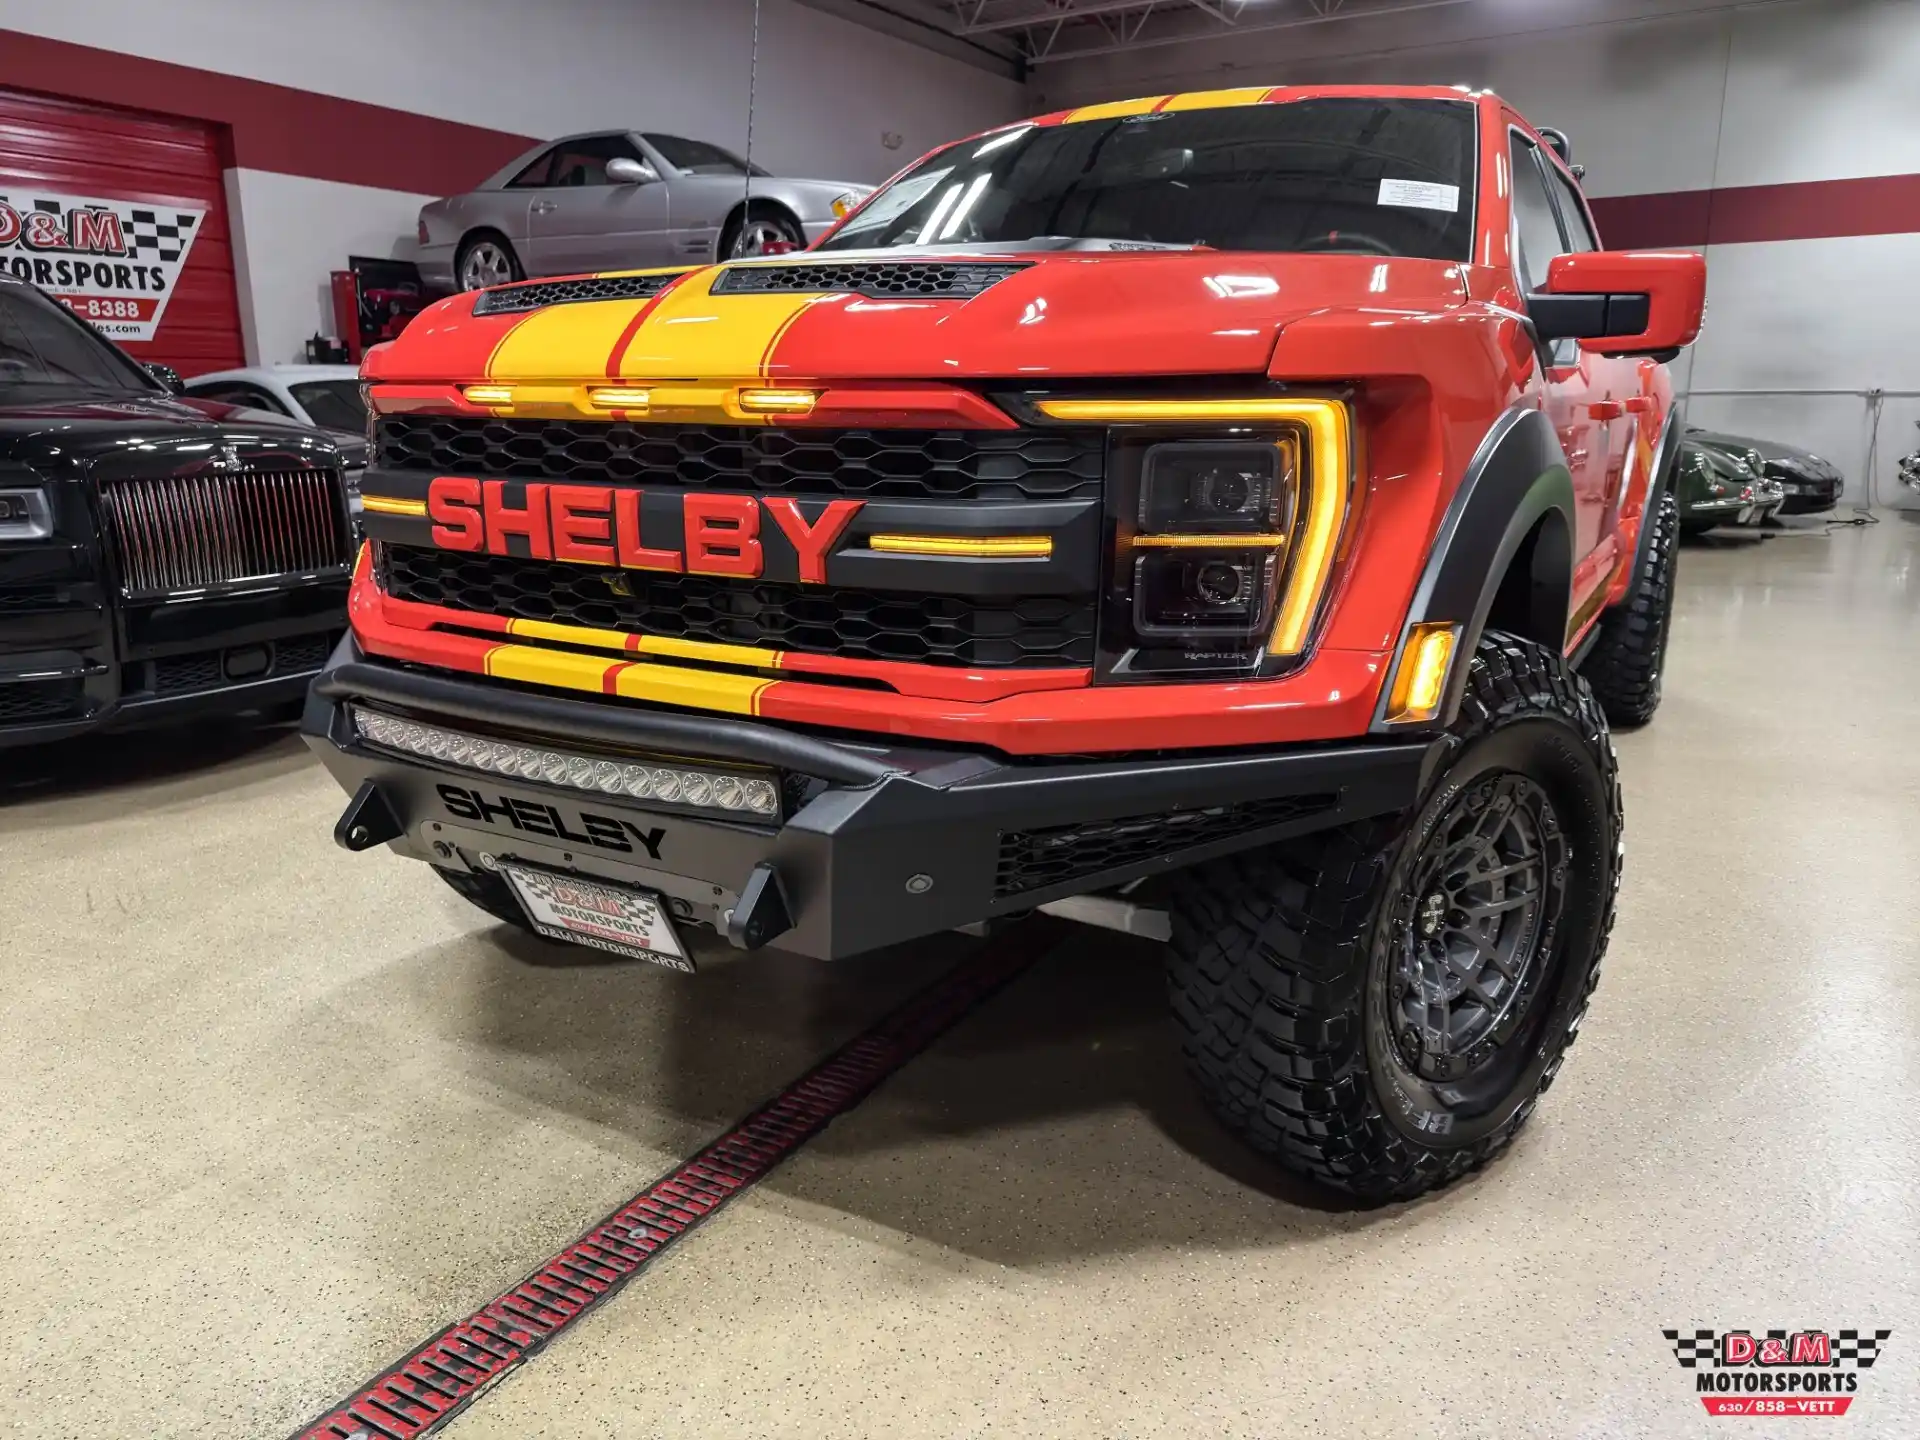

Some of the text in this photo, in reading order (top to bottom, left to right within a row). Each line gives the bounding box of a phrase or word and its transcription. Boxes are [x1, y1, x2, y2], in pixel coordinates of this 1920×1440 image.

[428, 477, 869, 584] SHELBY
[436, 783, 666, 860] SHELBY
[537, 924, 690, 973] D&M MOTORSPORTS
[549, 902, 650, 937] MOTORSPORTS
